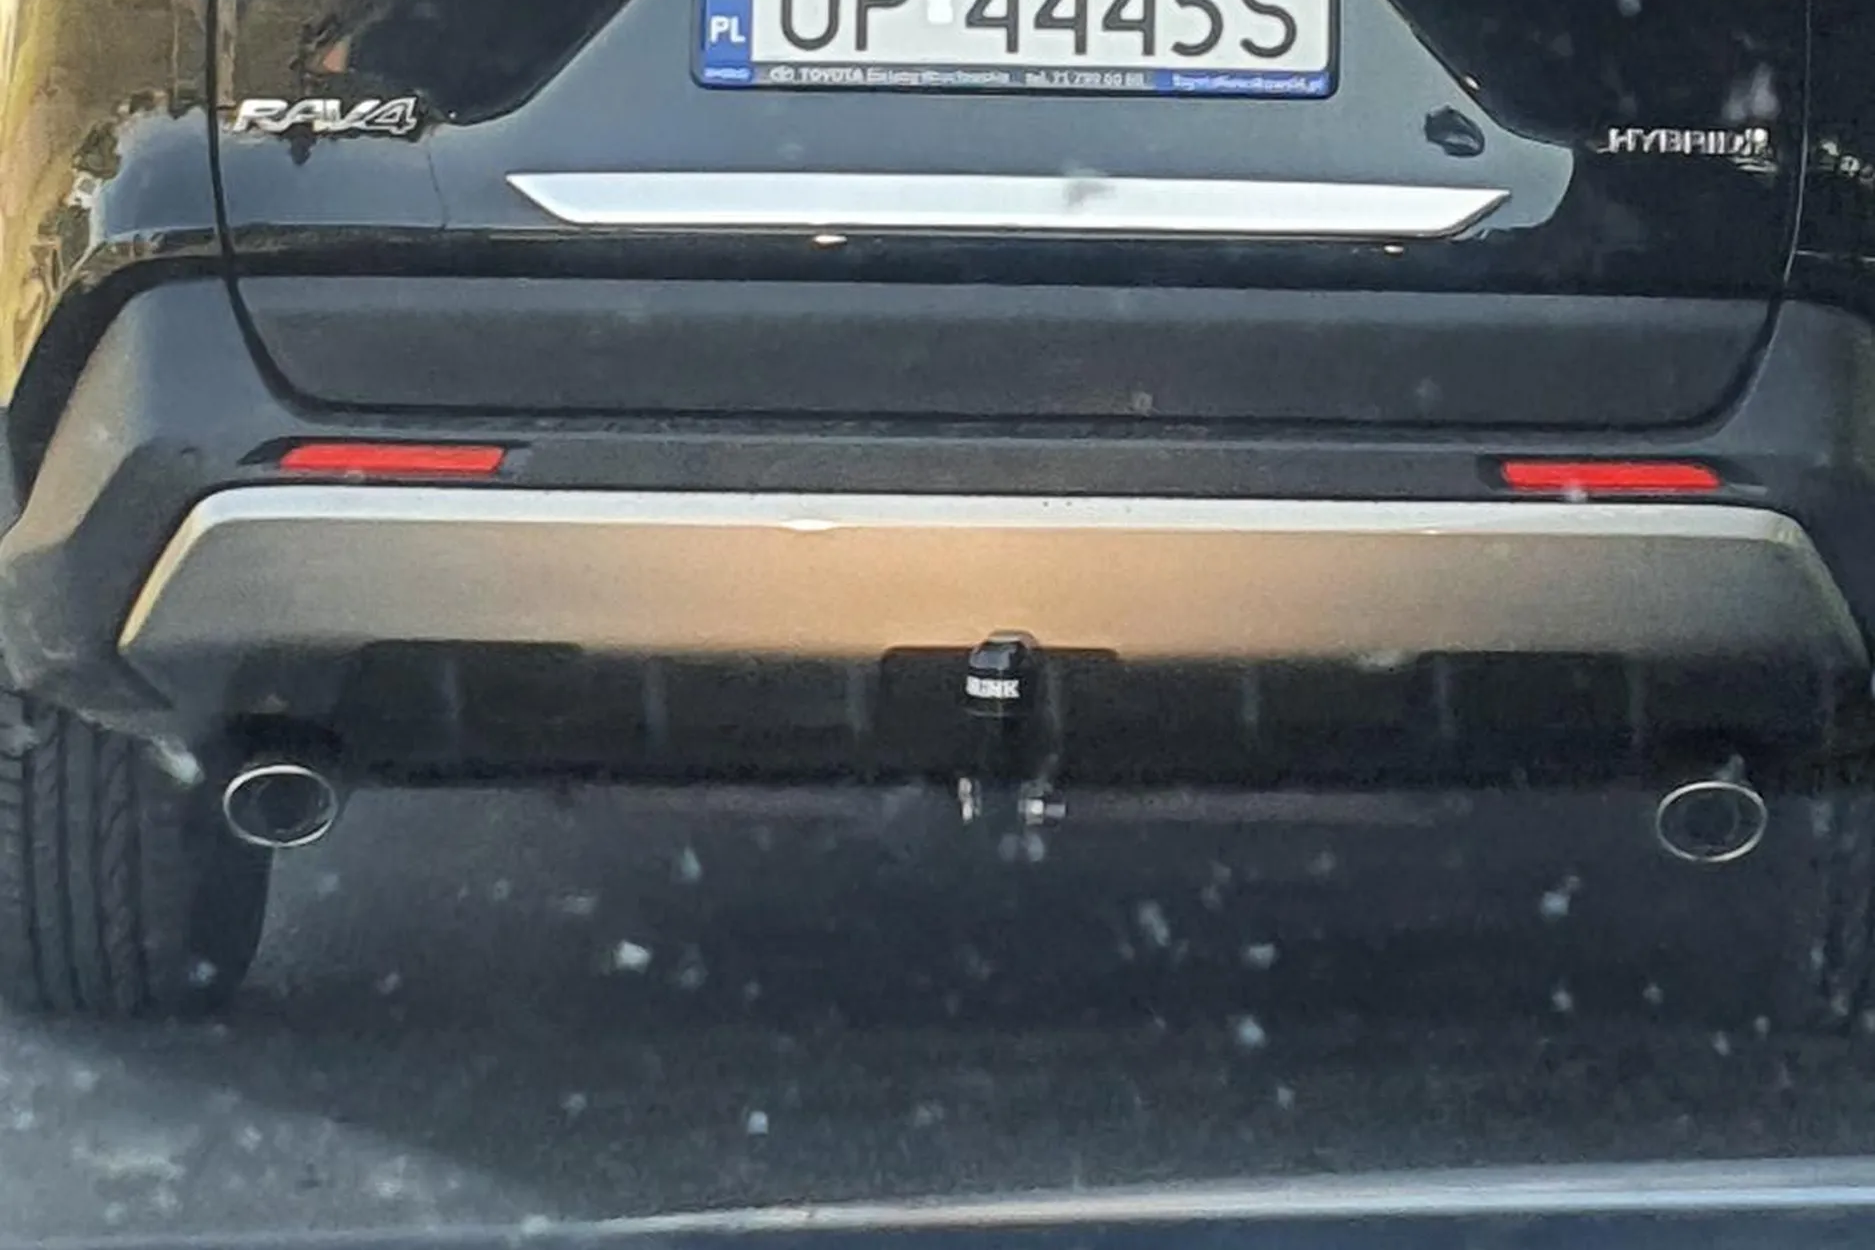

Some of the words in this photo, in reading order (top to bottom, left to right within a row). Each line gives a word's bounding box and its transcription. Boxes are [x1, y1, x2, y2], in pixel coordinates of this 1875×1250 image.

[710, 15, 746, 43] PL
[799, 67, 864, 83] TOYOTA
[232, 97, 417, 135] RAV4
[1607, 128, 1752, 154] HYBRID
